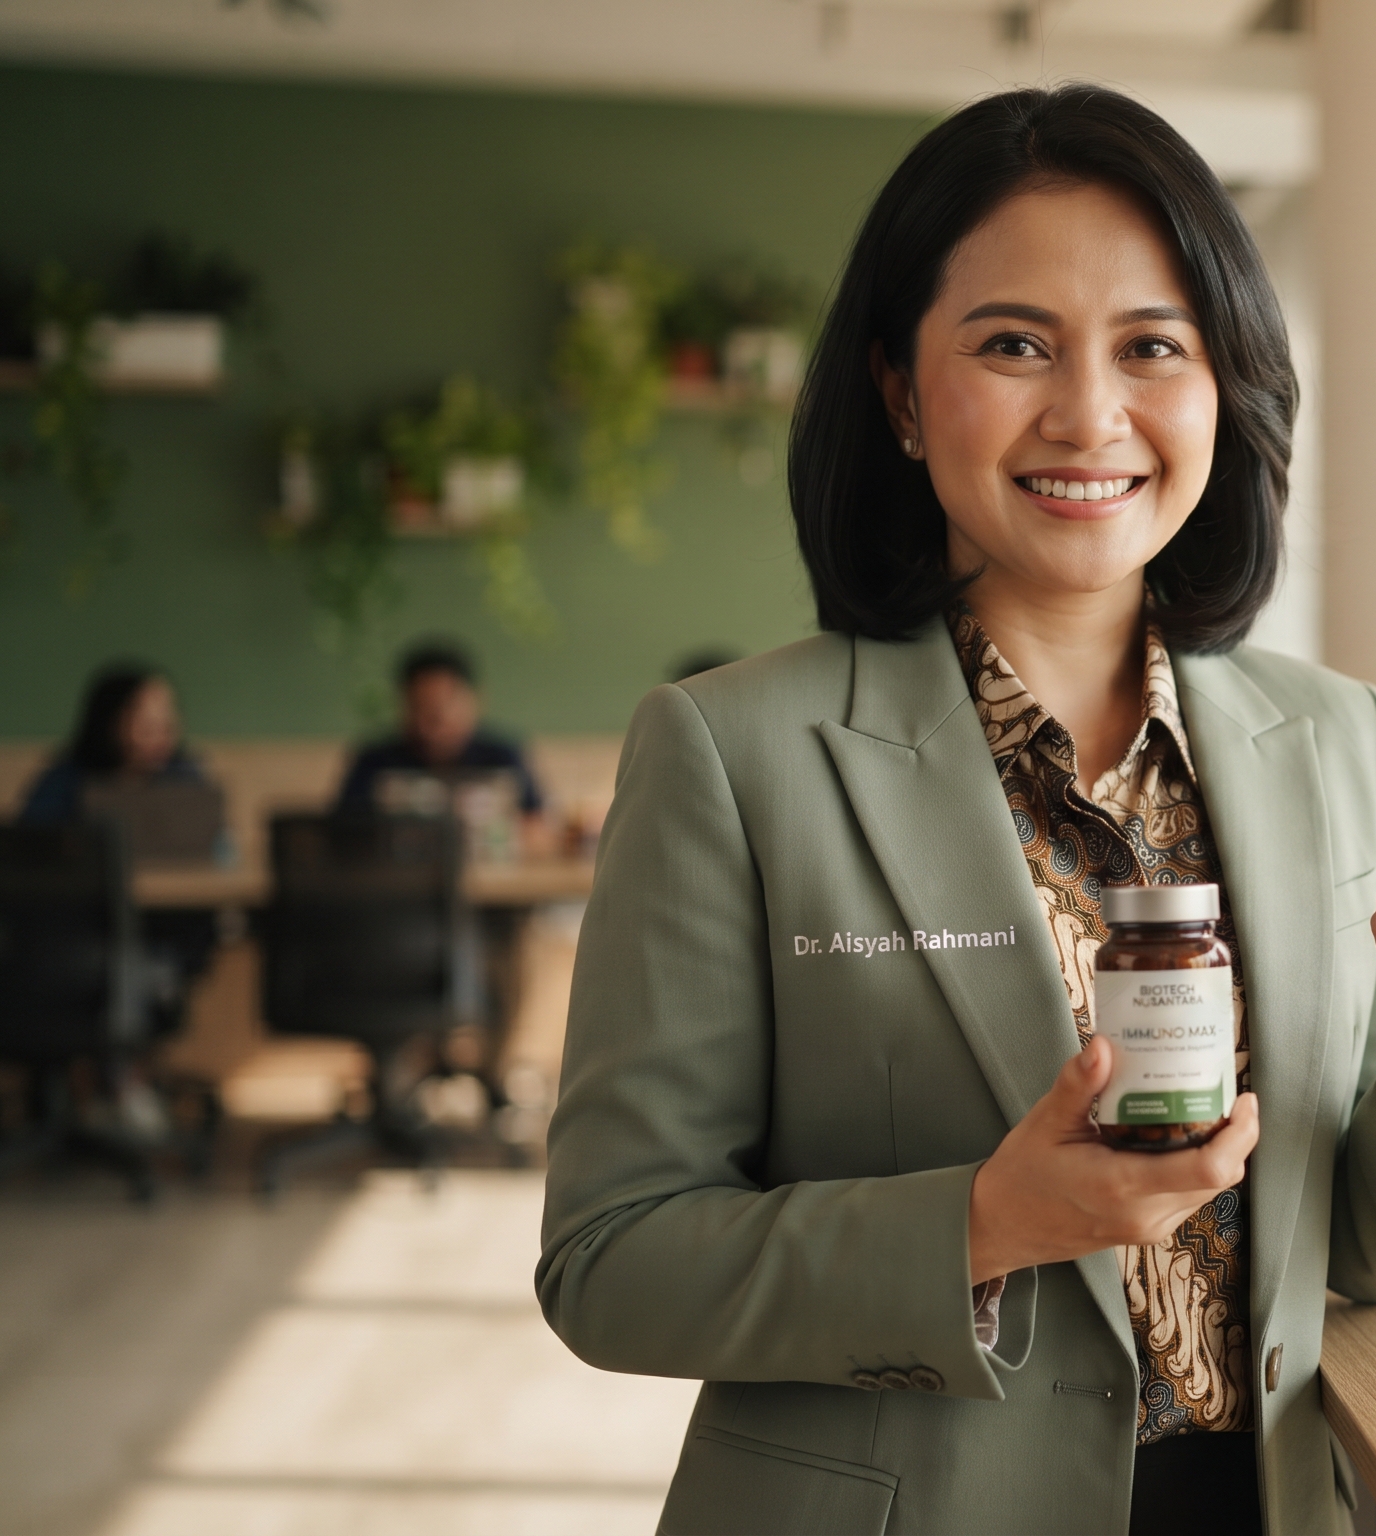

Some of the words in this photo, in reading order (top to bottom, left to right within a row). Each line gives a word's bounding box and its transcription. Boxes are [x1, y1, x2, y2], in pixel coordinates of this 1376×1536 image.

[793, 935, 823, 956] Dr.
[829, 931, 905, 958] Aisyah
[913, 926, 1016, 950] Rahmani
[1140, 984, 1195, 996] BIOTECH
[1122, 1027, 1185, 1040] IMMUNO
[1188, 1025, 1217, 1038] MAX
